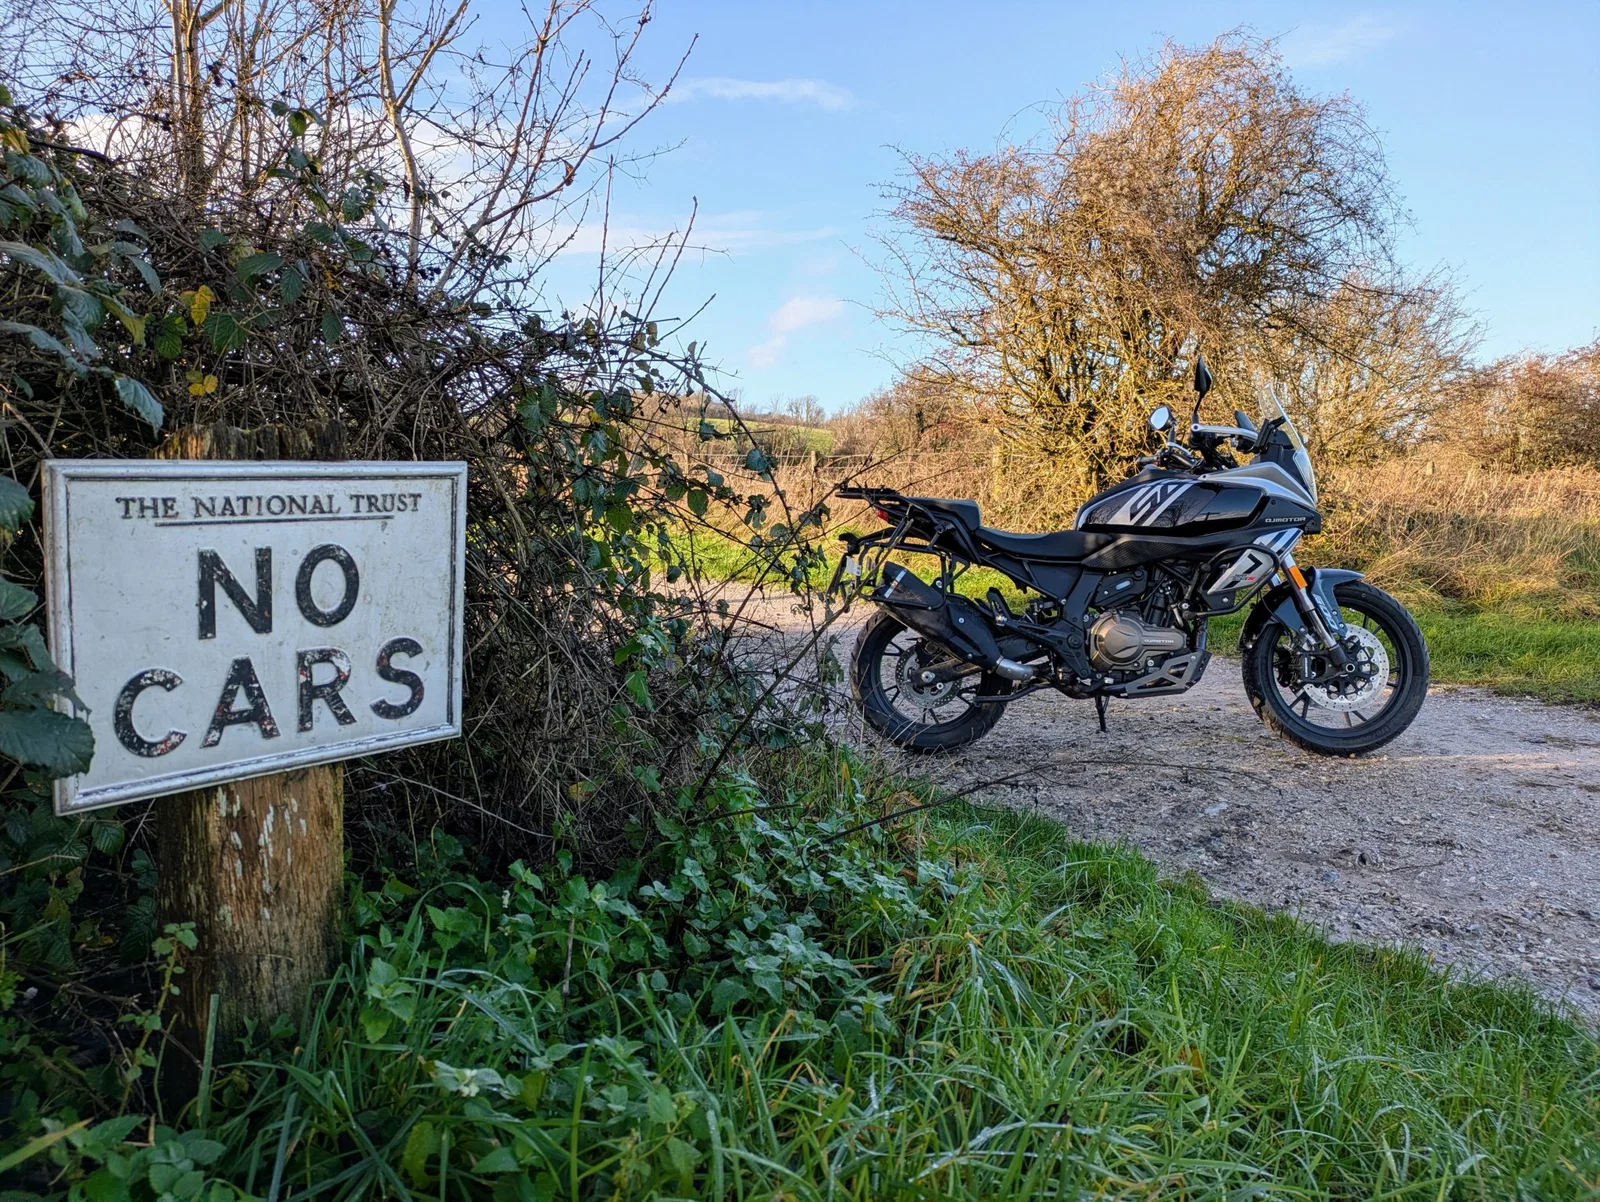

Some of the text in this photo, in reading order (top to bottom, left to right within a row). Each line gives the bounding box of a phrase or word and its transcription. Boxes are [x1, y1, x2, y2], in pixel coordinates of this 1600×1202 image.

[115, 493, 422, 519] THE NATIONAL TRUST
[198, 543, 360, 640] NO
[113, 637, 425, 758] CARS
